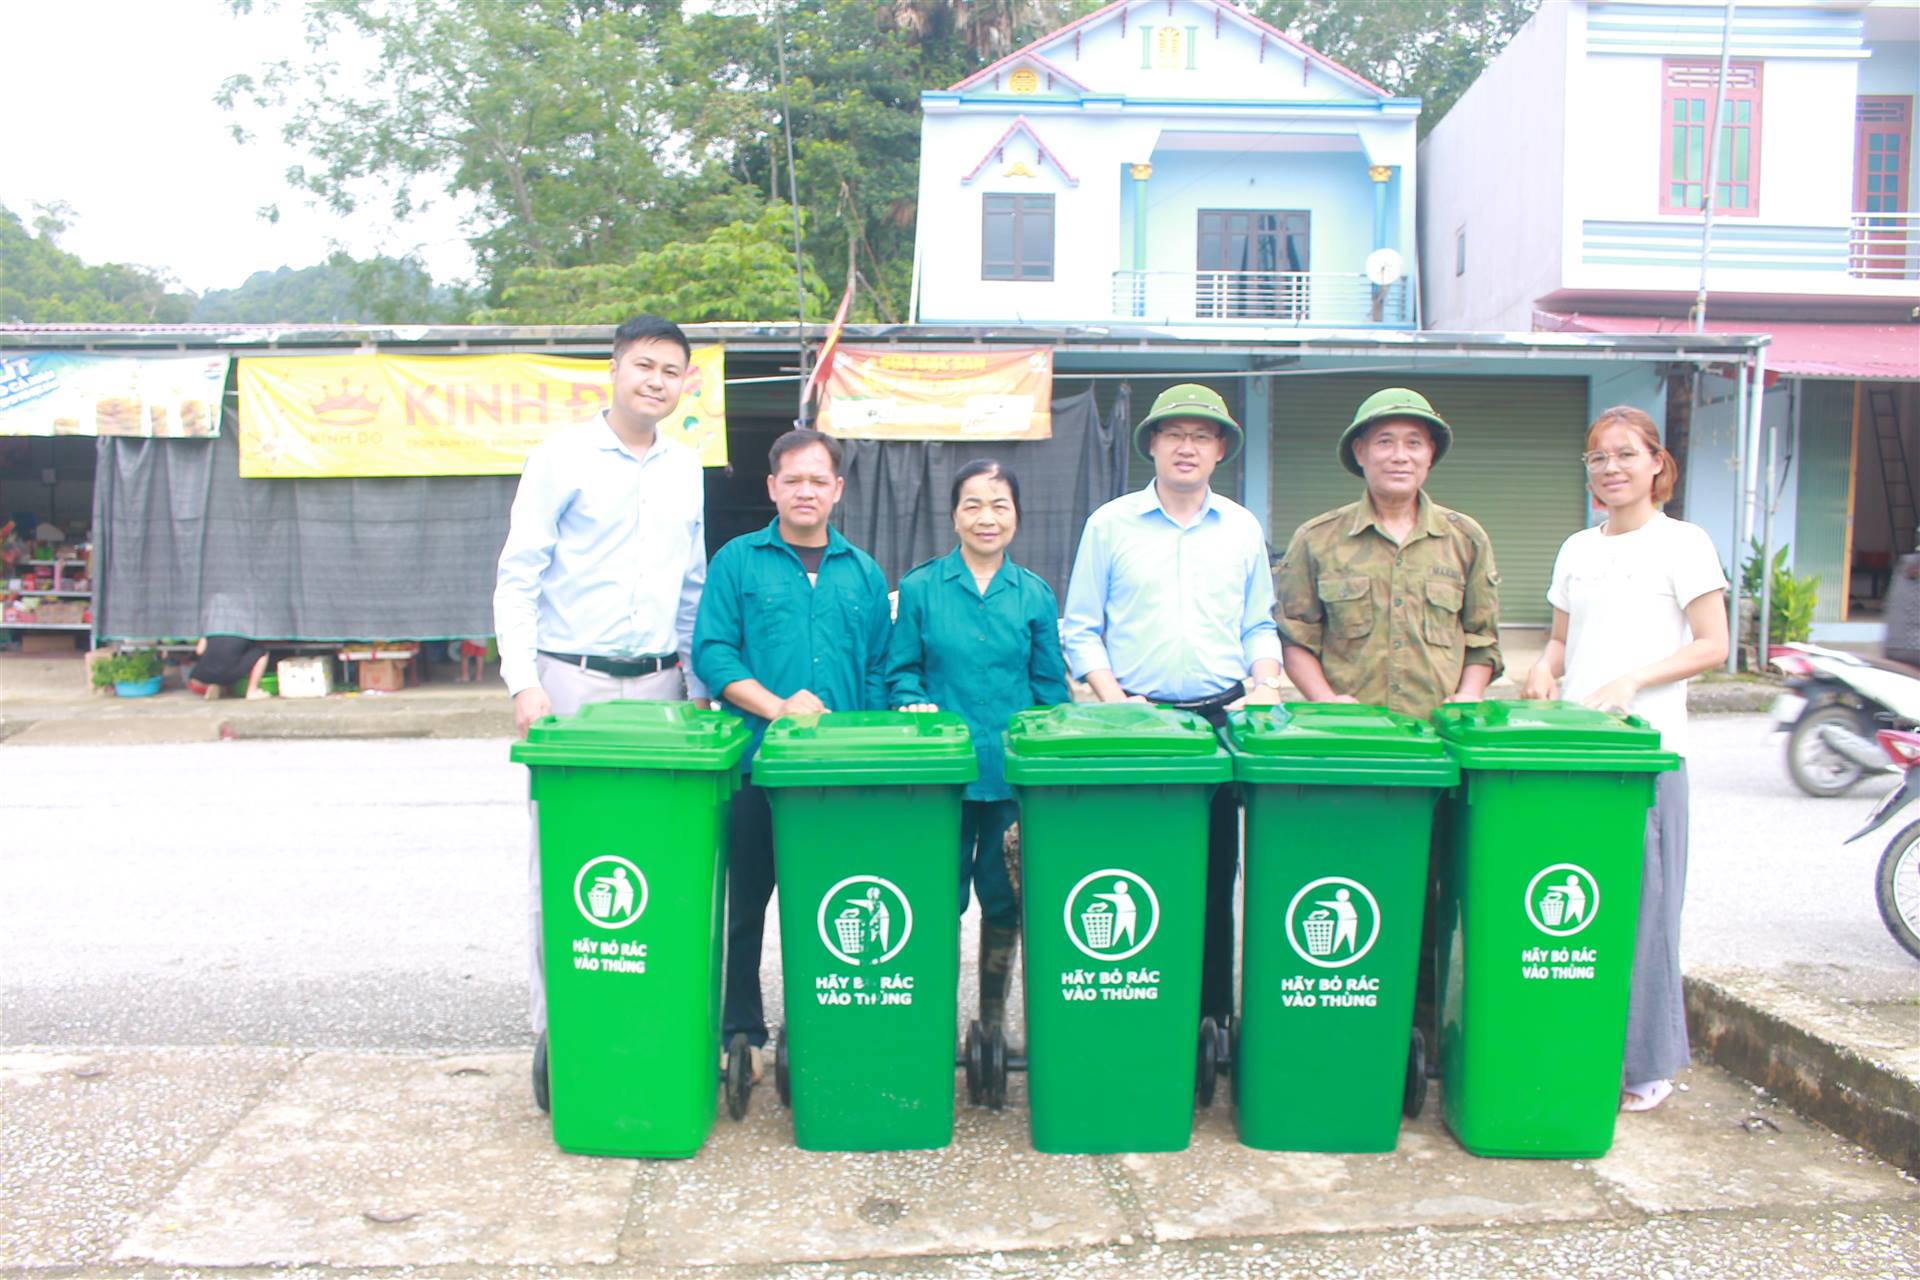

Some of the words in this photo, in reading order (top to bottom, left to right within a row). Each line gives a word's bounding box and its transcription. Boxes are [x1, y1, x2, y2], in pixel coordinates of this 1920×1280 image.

[405, 383, 548, 426] KINH
[565, 383, 608, 422] Đ
[309, 432, 351, 445] KINH
[573, 937, 599, 953] HÃY
[621, 940, 648, 957] RÁC
[1522, 947, 1549, 962] HÃY
[1571, 946, 1597, 962] RÁC
[574, 954, 600, 971] VÀO
[600, 956, 646, 974] THÙNG
[1522, 963, 1549, 979] VÀO
[1551, 963, 1595, 979] THÙNG
[816, 973, 850, 989] HÃY
[880, 973, 914, 989] RÁC
[1061, 969, 1096, 984] HÃY
[1099, 968, 1123, 984] BỎ
[1126, 967, 1160, 983] RÁC
[1281, 975, 1316, 991] HÃY
[1319, 975, 1342, 991] BỎ
[1346, 975, 1380, 991] RÁC
[816, 989, 852, 1005] VÀO
[1062, 985, 1097, 1001] VÀO
[1100, 984, 1158, 1000] THÙNG
[1282, 991, 1317, 1007] VÀO
[1319, 991, 1377, 1007] THÙNG
